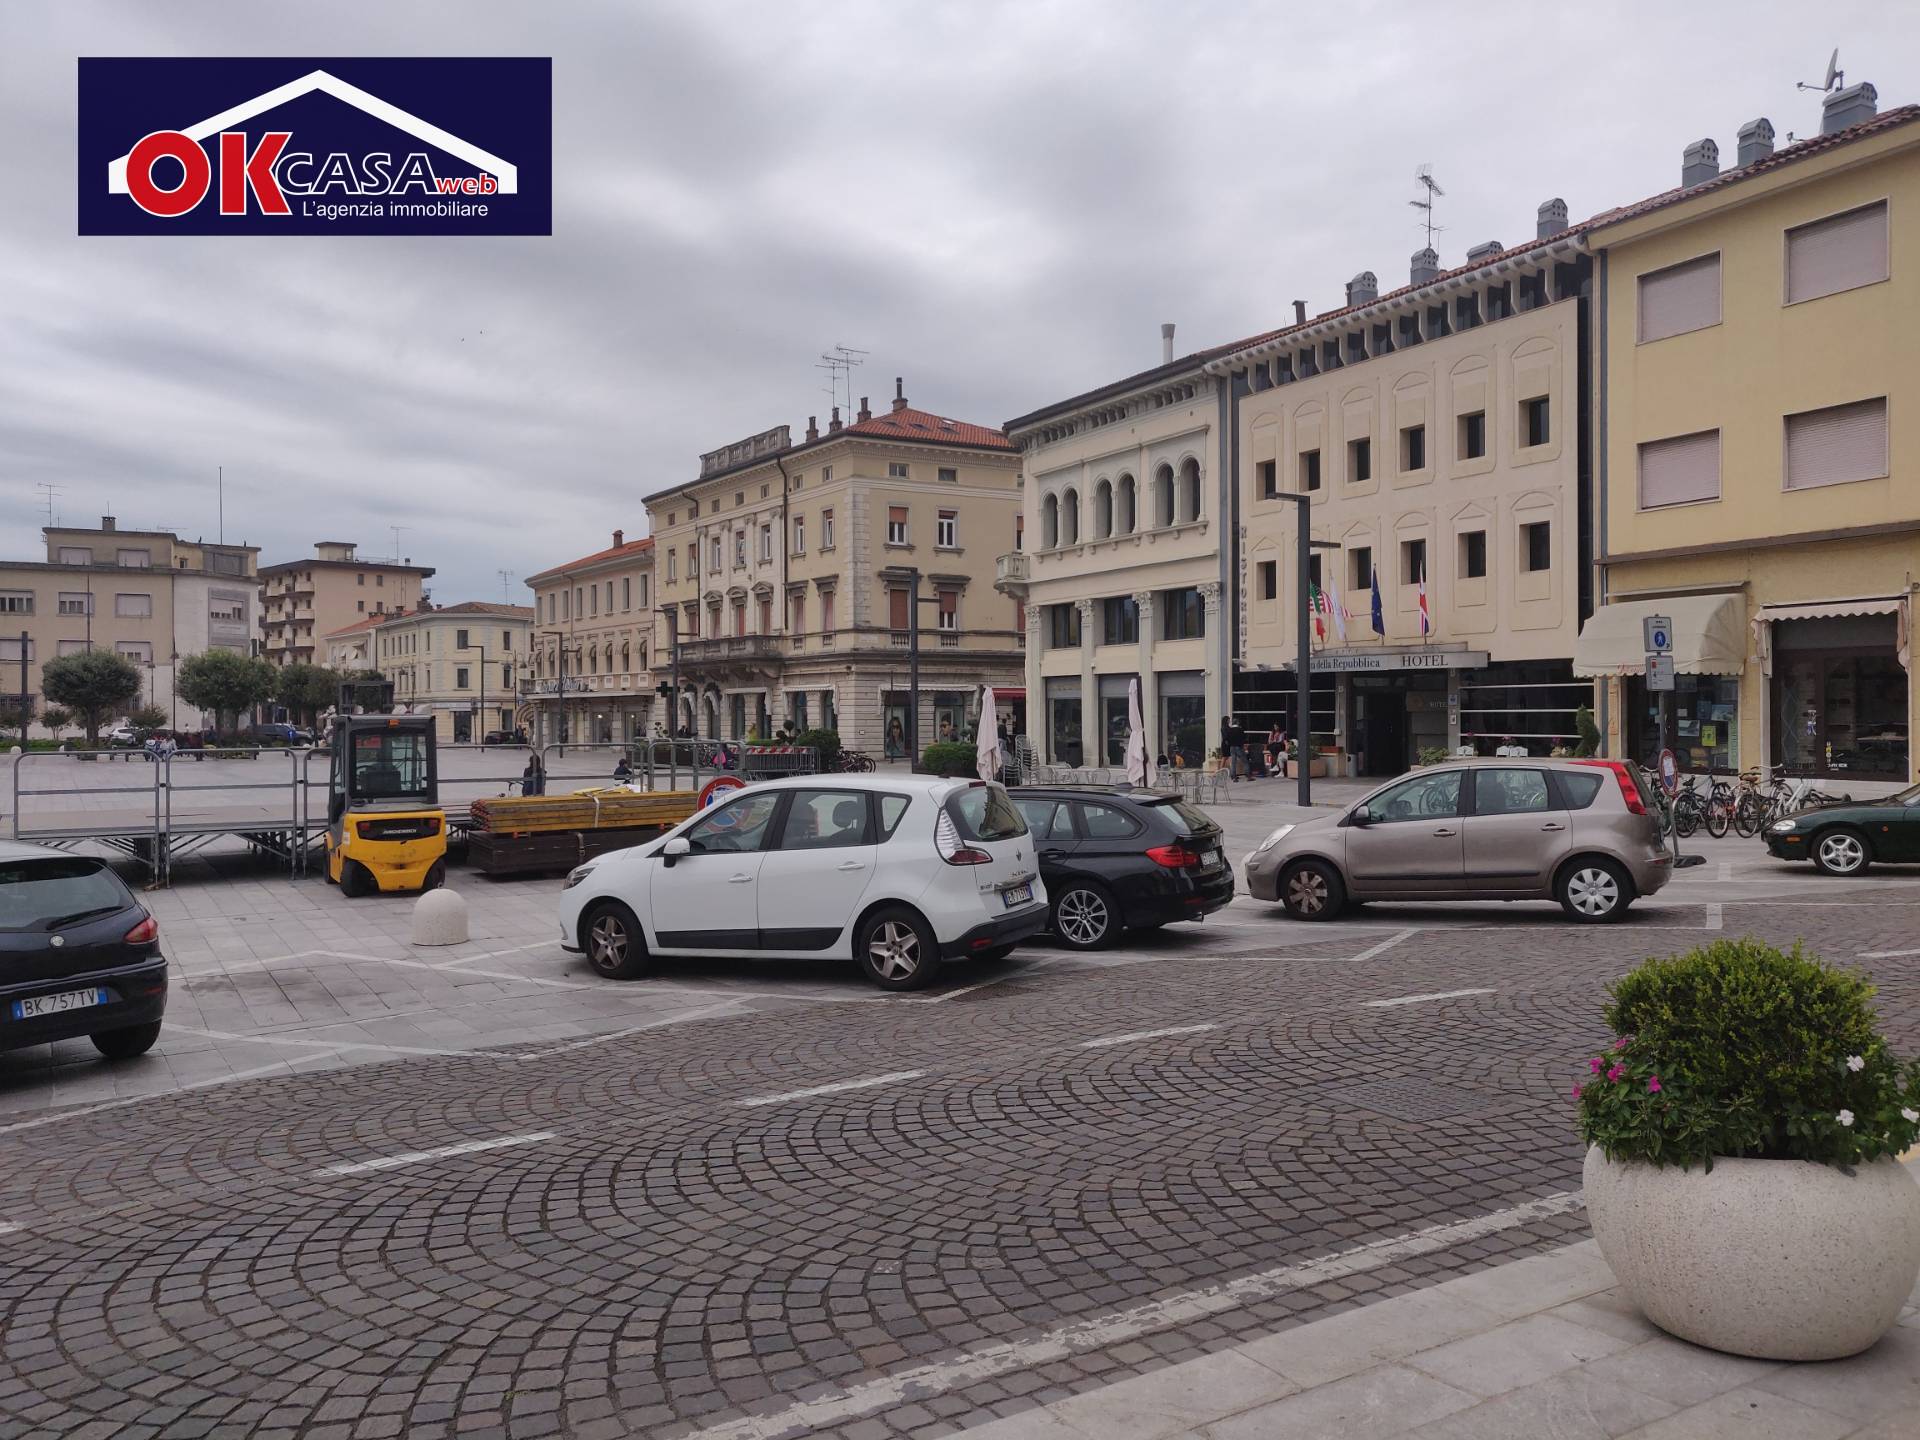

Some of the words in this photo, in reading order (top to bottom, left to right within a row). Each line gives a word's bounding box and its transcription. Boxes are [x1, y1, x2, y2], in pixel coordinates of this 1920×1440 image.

[1316, 658, 1332, 669] della
[1333, 656, 1381, 671] Repubblica
[1402, 654, 1449, 667] HOTEL
[24, 999, 44, 1015] BK
[48, 989, 95, 1011] 757TV
